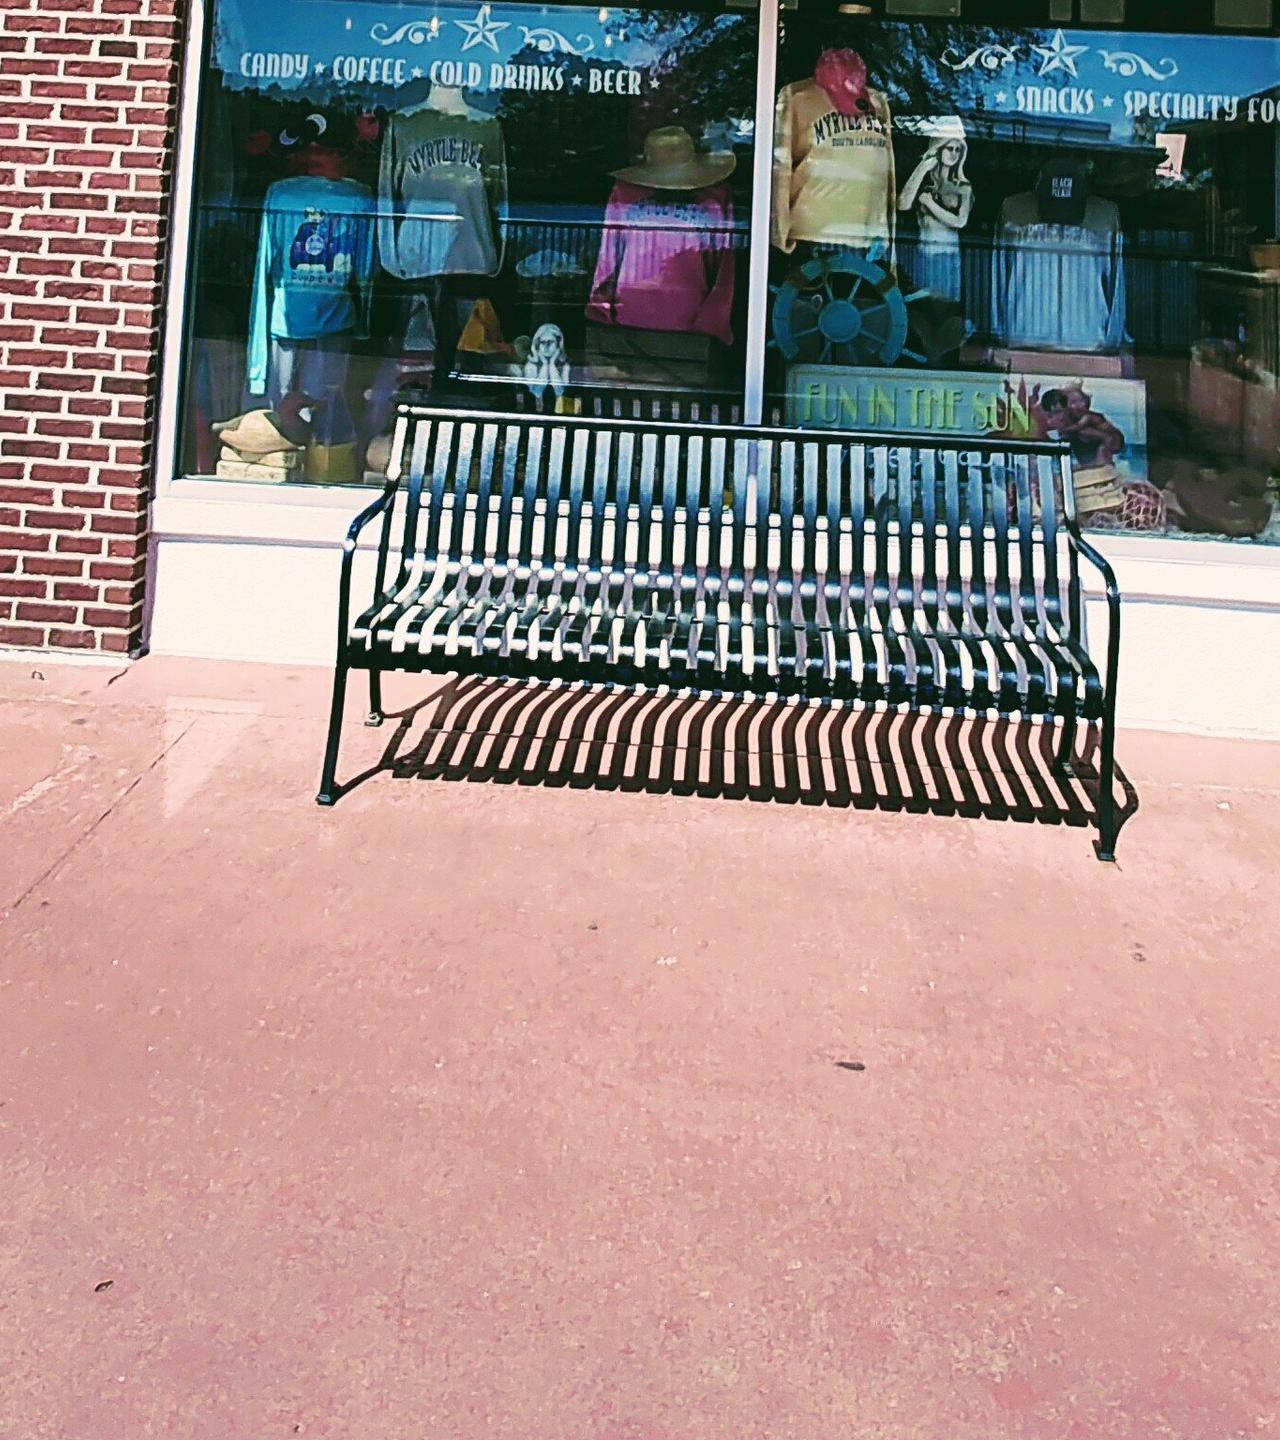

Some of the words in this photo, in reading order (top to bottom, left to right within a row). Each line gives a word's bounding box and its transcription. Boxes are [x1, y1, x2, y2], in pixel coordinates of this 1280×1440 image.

[239, 52, 309, 79] CANDY
[332, 56, 407, 84] COFFEE
[429, 60, 482, 88] COLD
[489, 63, 567, 91] DRINKS
[588, 68, 642, 95] BEER
[1015, 86, 1094, 115] SNACKS
[1123, 90, 1239, 122] SPECIALTY
[804, 382, 860, 423] FUN
[869, 384, 899, 427] IN
[905, 387, 964, 430] THE
[972, 389, 1031, 433] SUN
